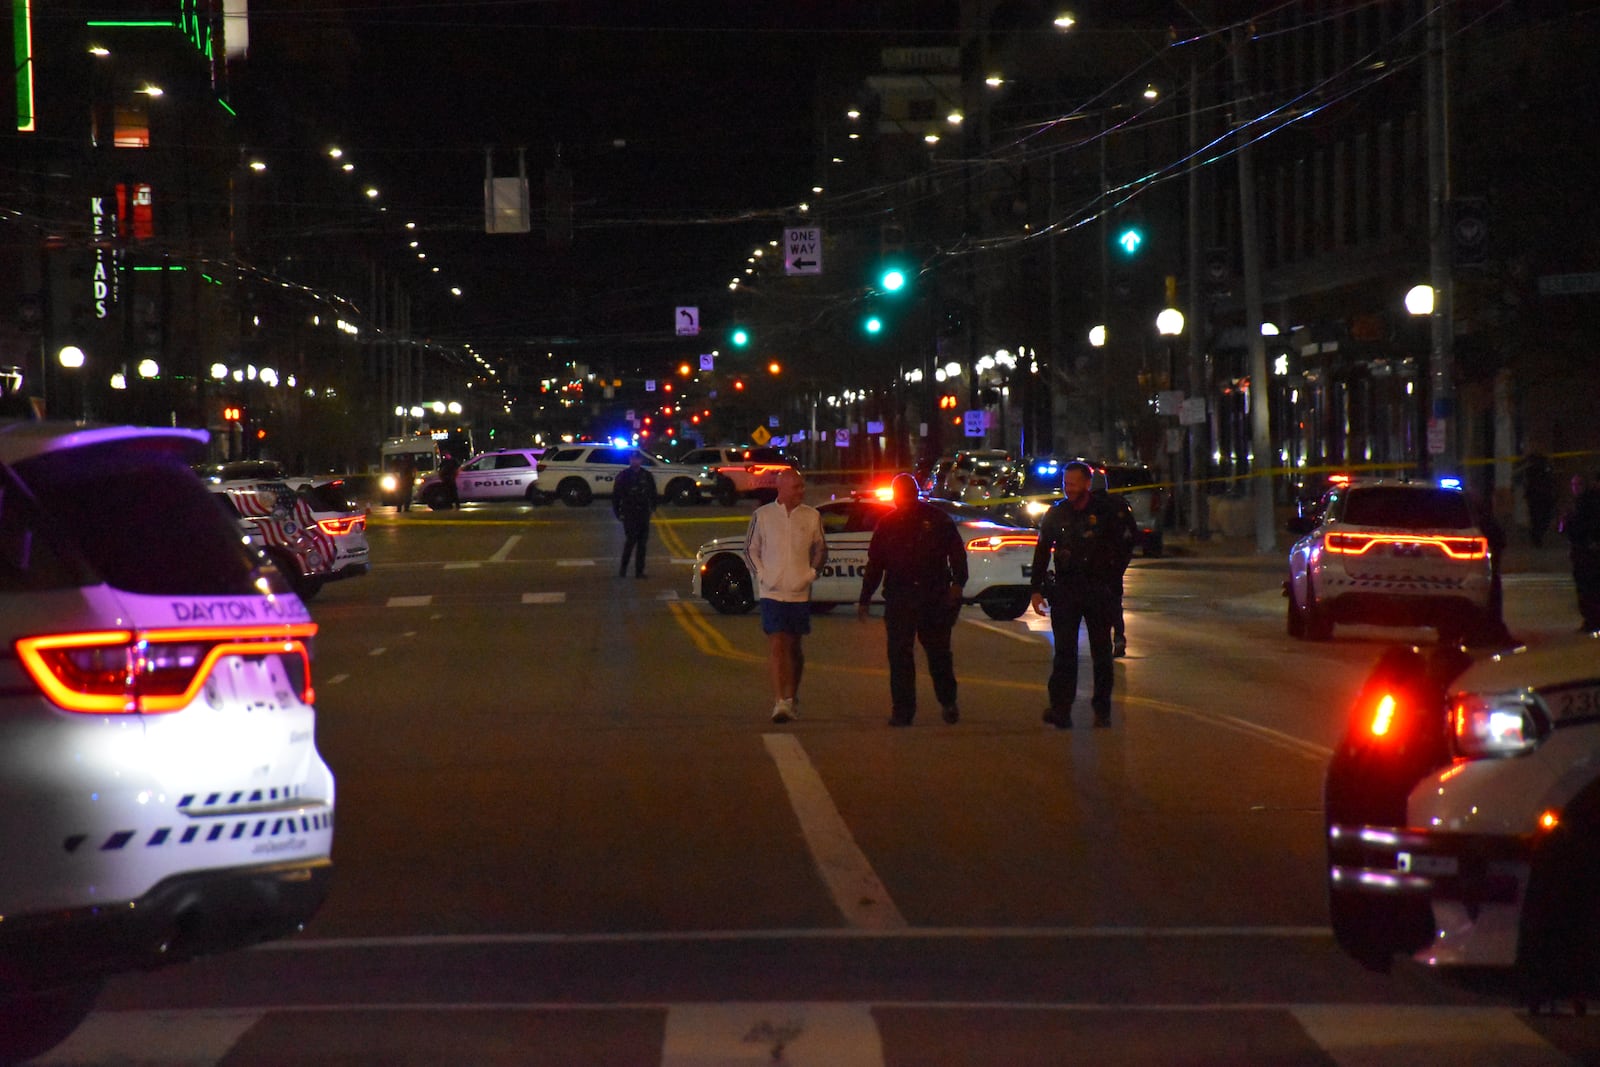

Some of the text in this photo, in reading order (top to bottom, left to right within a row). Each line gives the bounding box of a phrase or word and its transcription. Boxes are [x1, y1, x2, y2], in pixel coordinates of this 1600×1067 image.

[790, 231, 815, 241] ONE
[790, 243, 816, 255] WAY
[474, 479, 522, 488] POLICE
[823, 565, 867, 577] OLIC
[171, 601, 256, 621] DAYTON
